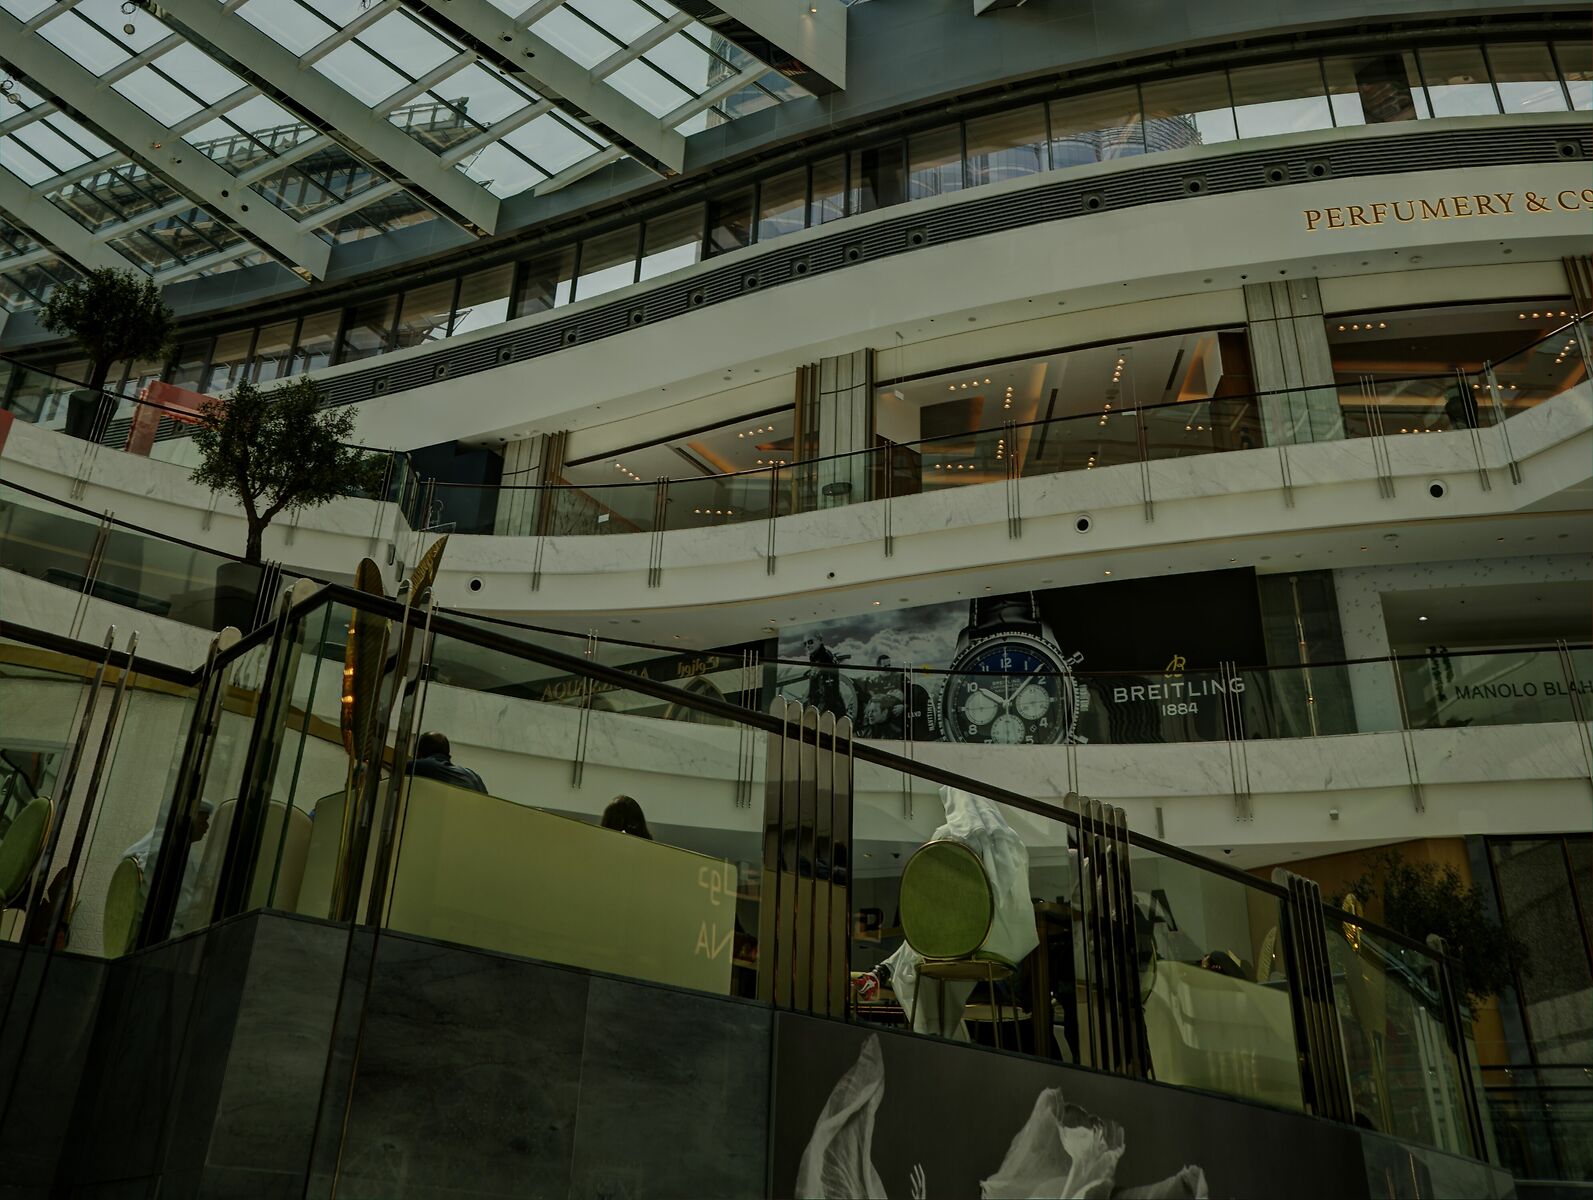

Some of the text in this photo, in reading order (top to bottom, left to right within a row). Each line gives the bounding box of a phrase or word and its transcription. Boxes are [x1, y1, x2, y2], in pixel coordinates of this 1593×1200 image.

[1304, 192, 1514, 231] PERFUMERY
[1525, 191, 1552, 212] &
[967, 681, 978, 693] 10
[1113, 677, 1246, 703] BREITLING
[1455, 682, 1537, 700] MANOLO
[1162, 702, 1200, 716] 1884
[968, 725, 977, 735] 8
